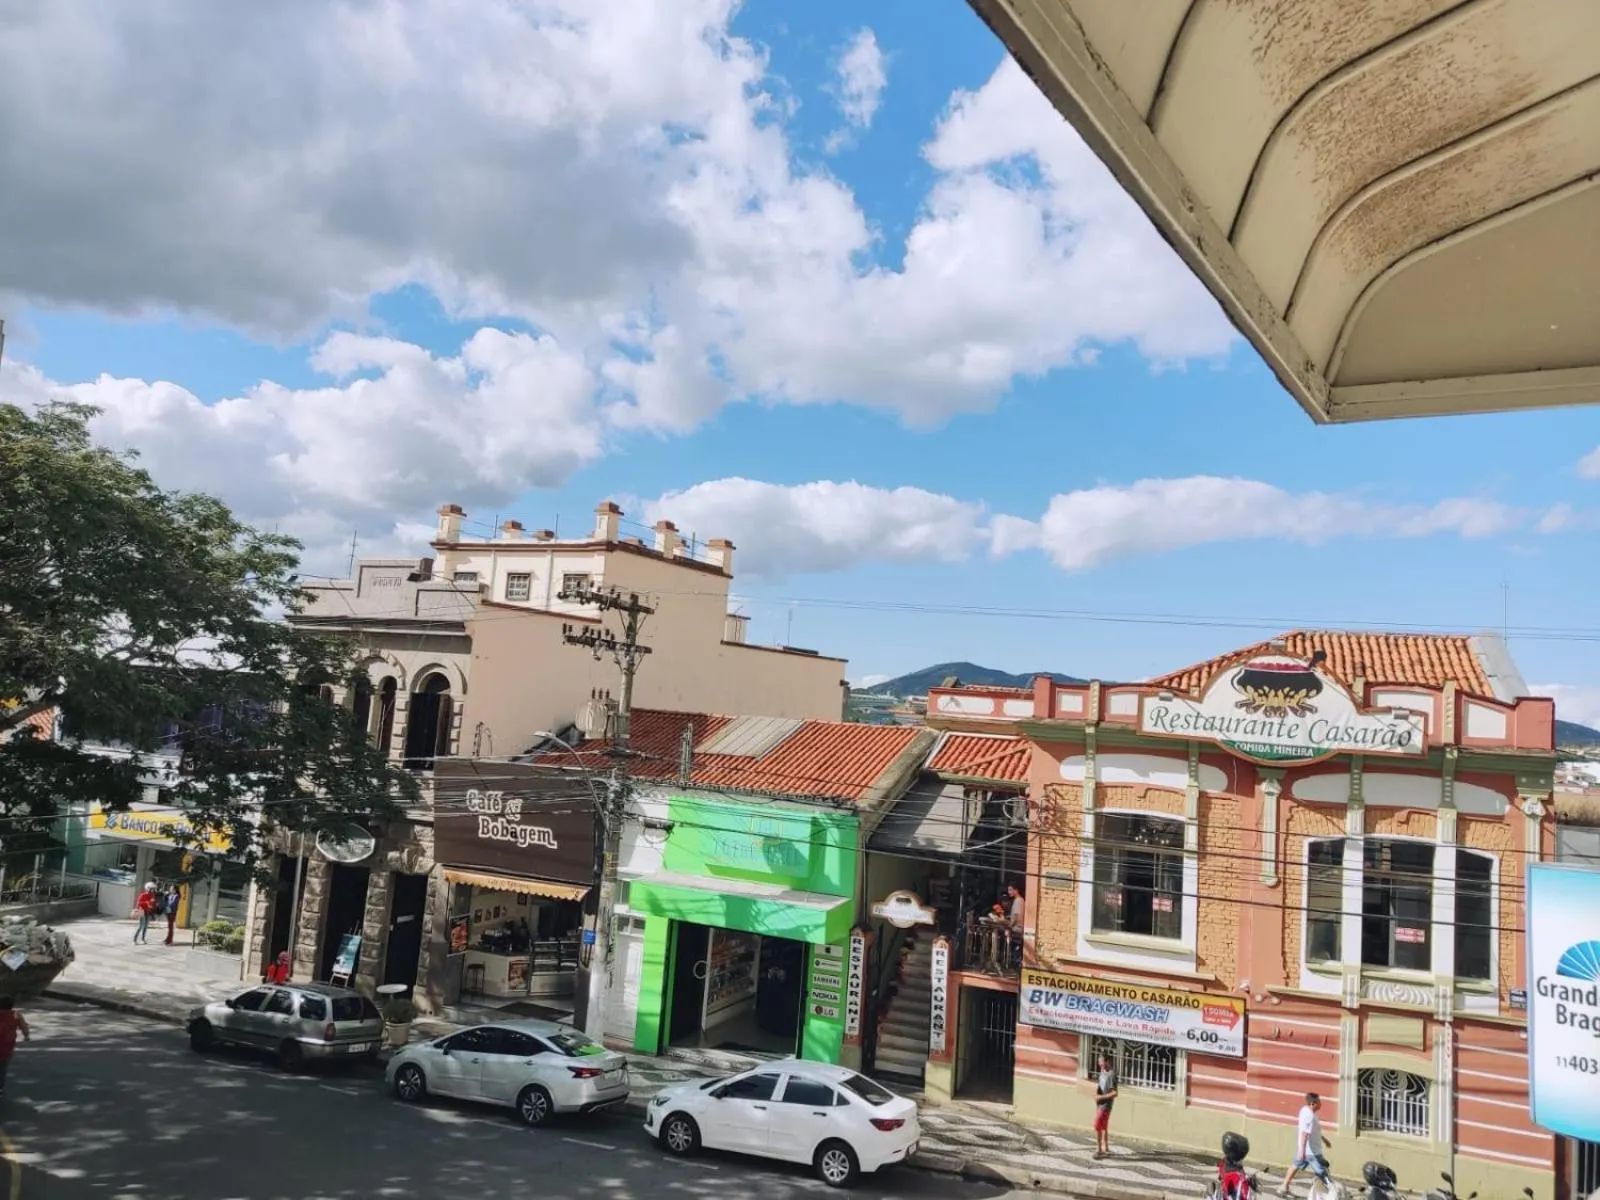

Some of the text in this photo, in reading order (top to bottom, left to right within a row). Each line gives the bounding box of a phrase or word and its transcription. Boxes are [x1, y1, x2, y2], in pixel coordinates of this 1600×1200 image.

[1150, 705, 1412, 747] Restaurante Casarão
[1235, 742, 1314, 757] COMIDA MINEIRA
[467, 789, 523, 820] Café &
[120, 814, 158, 834] BANCO
[479, 816, 557, 849] Bobagem
[812, 991, 838, 1001] NOKIA
[1028, 975, 1200, 1009] ESTACIONAMENTO CASARÃO
[1029, 989, 1169, 1023] BW BRAGWASH
[1536, 976, 1600, 1006] Grand
[1556, 1003, 1600, 1038] Brag
[1187, 1028, 1219, 1044] 6,00
[1556, 1055, 1600, 1075] 11403
